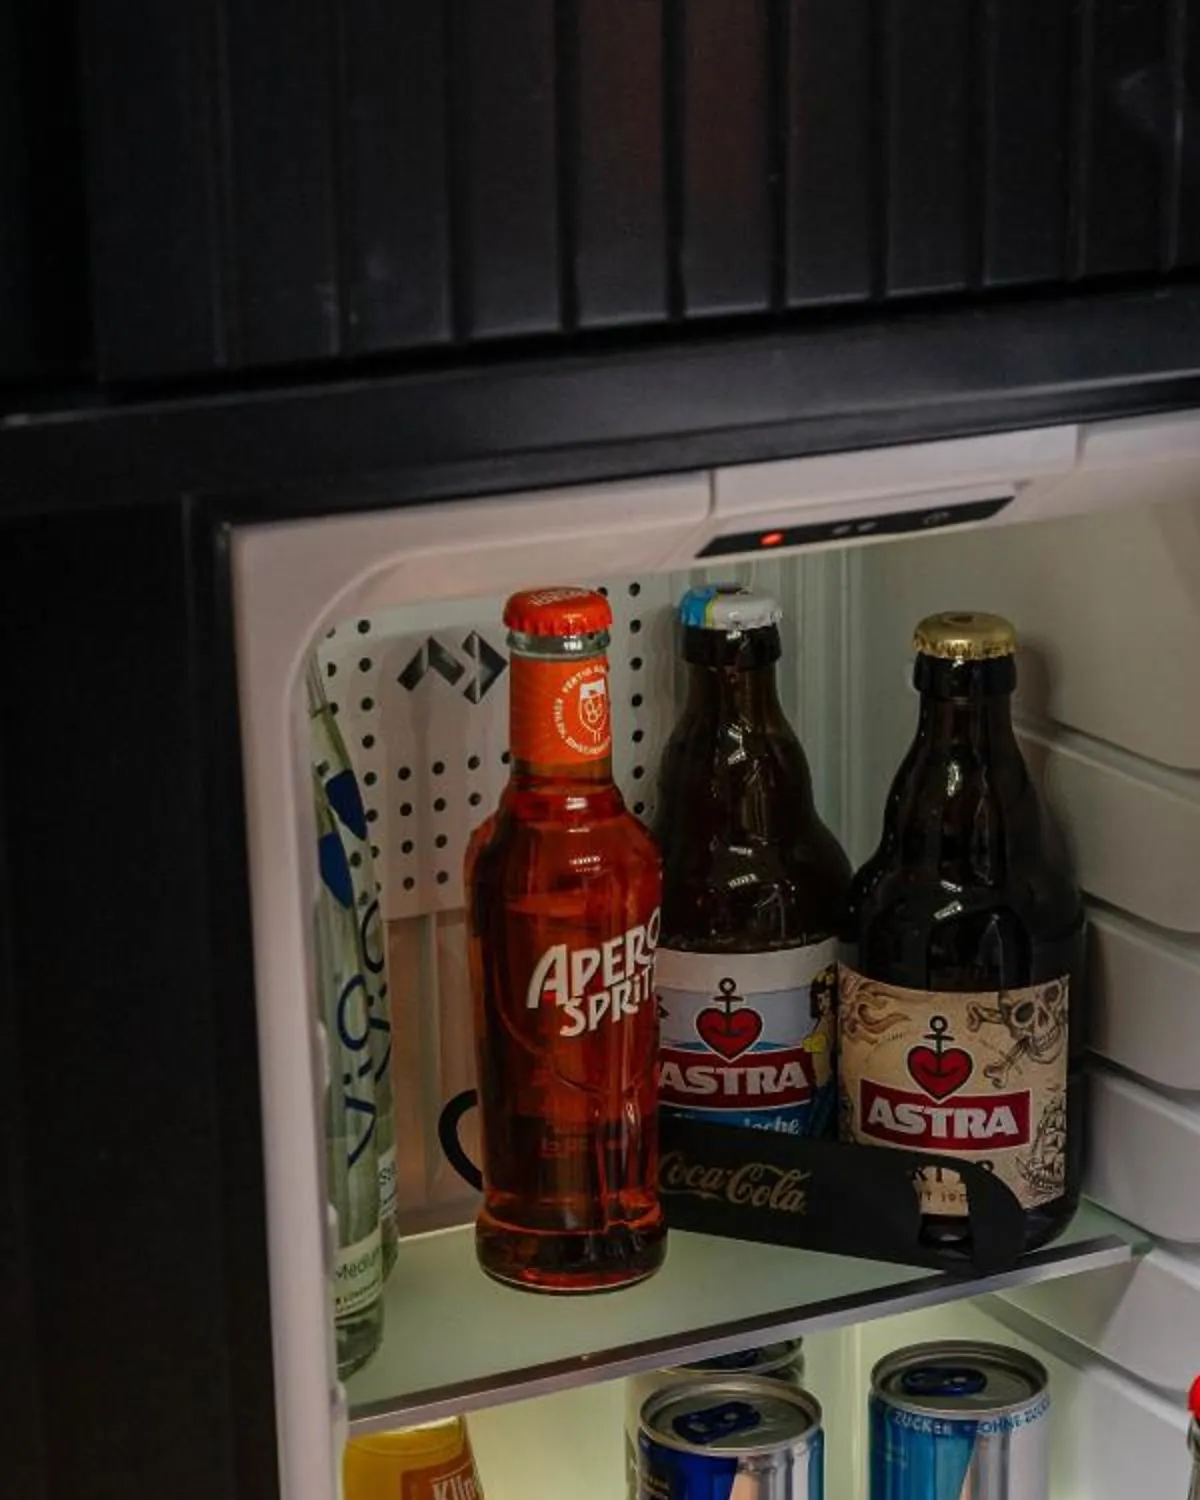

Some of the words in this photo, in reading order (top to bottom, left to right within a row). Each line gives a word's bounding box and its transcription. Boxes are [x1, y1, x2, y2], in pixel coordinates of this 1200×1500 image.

[527, 907, 662, 1009] APERO
[560, 965, 656, 1037] SPRiT
[659, 1061, 809, 1096] ASTRA
[868, 1096, 1020, 1140] ASTRA
